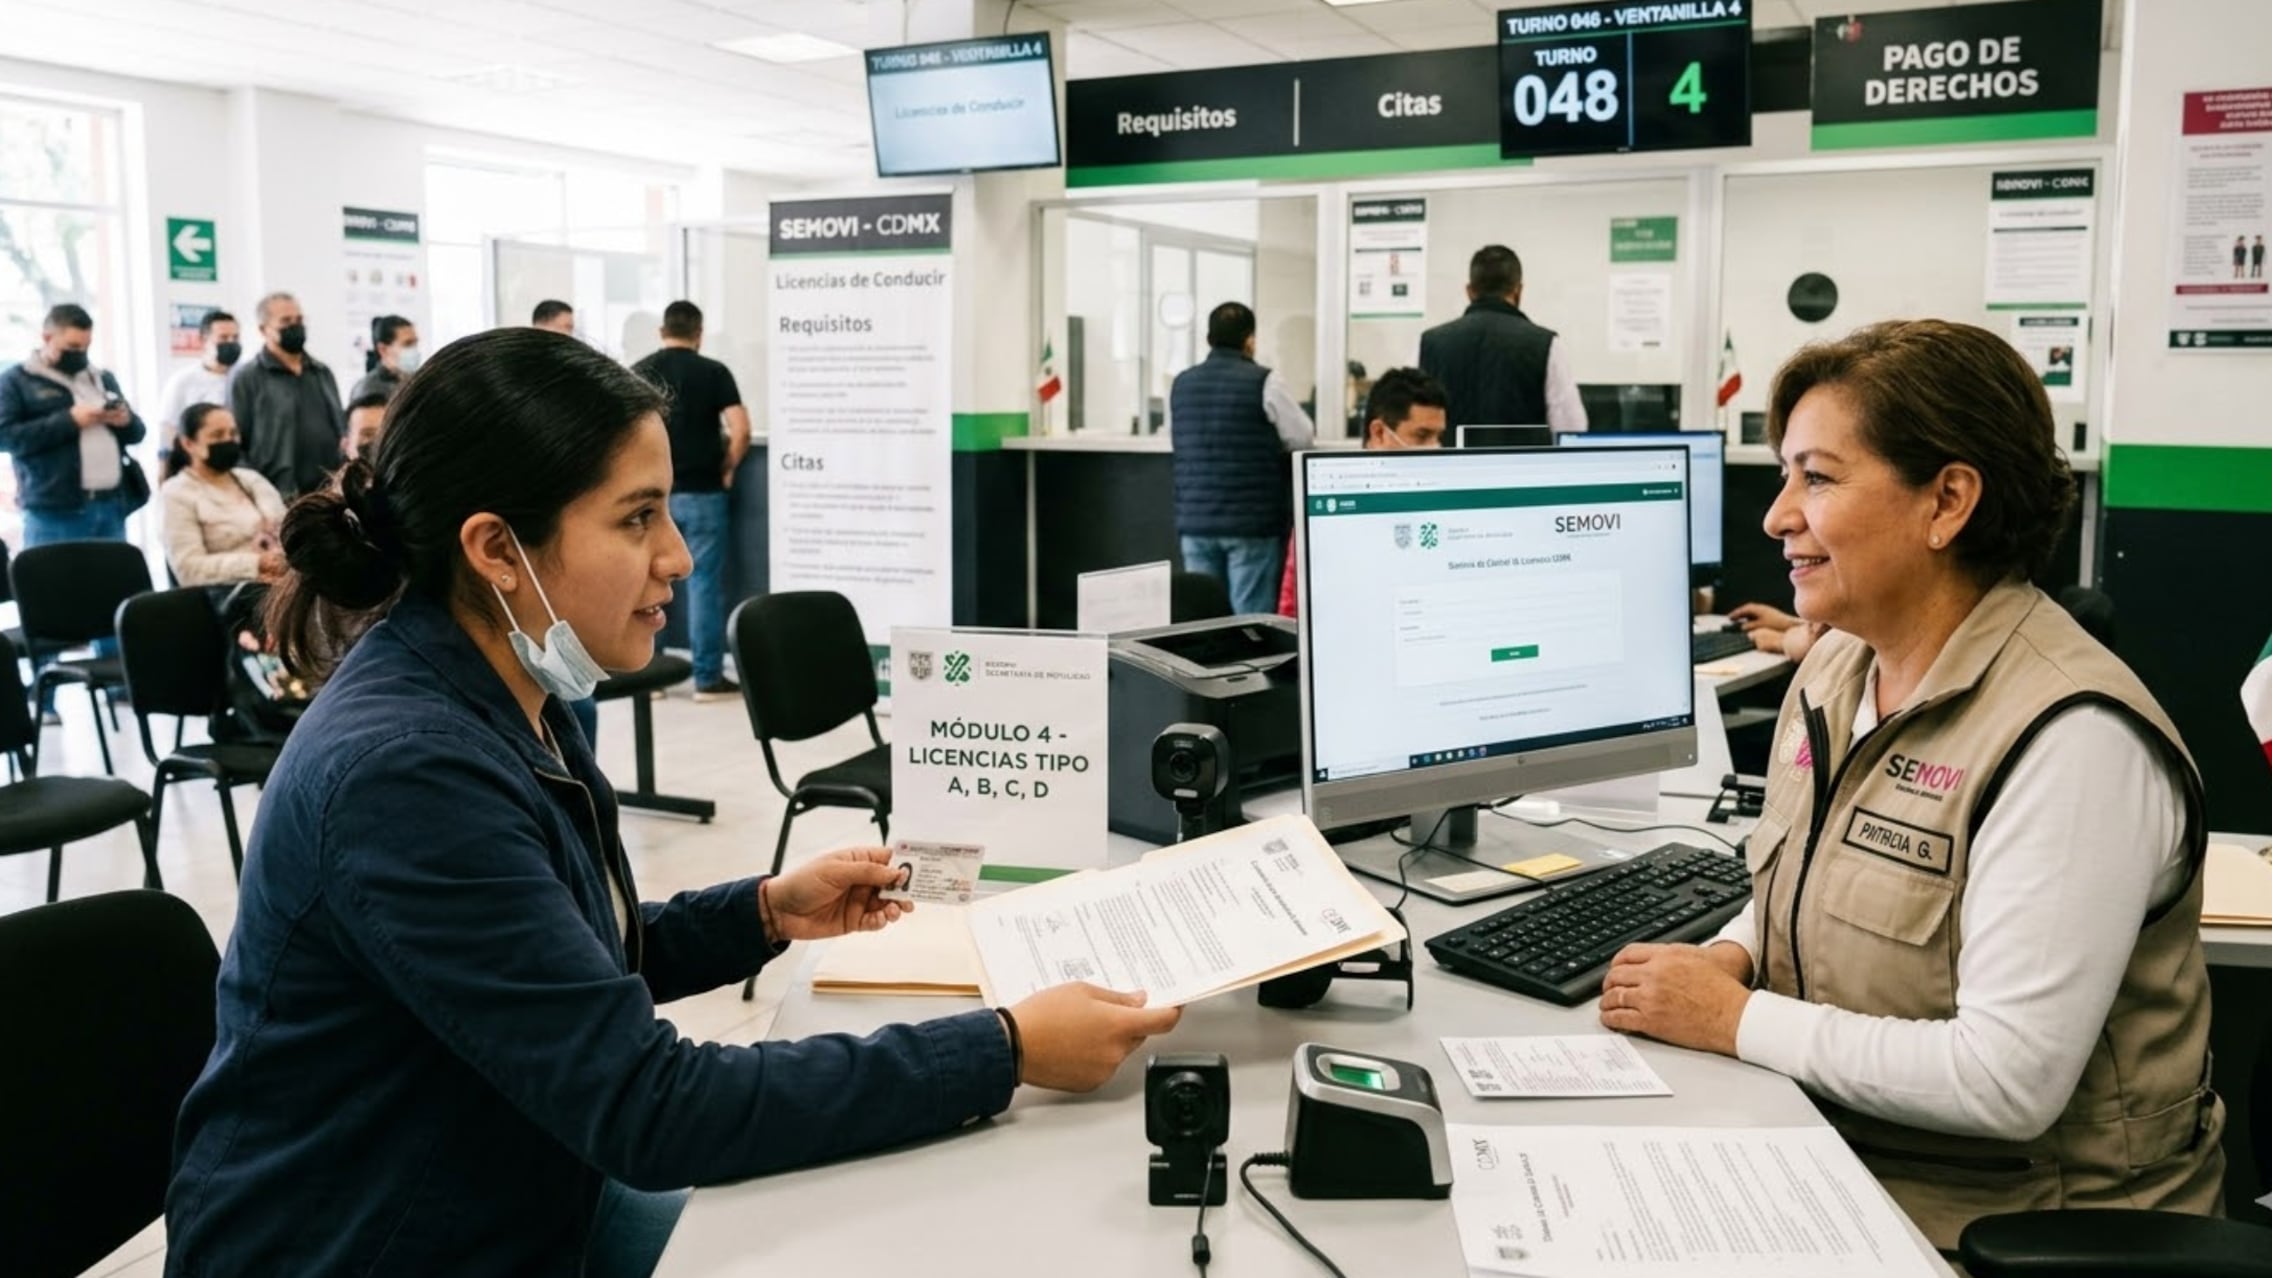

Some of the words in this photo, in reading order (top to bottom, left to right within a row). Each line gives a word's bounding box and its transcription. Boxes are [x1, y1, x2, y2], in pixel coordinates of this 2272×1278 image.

[1506, 13, 1569, 35] TURNO
[1613, 1, 1727, 26] VENTANILLA
[1728, 0, 1742, 16] 4
[1533, 45, 1598, 67] TURNO
[1883, 40, 1970, 72] PAGO
[1978, 36, 2021, 66] DE
[1513, 69, 1619, 126] 048
[1669, 61, 1707, 114] 4
[1864, 69, 2039, 106] DERECHOS
[1377, 91, 1442, 118] Citas
[1117, 105, 1237, 137] Requisitos
[779, 216, 859, 240] SEMOVI
[876, 212, 941, 236] CDMX
[775, 273, 847, 291] Licencias
[849, 272, 870, 288] de
[872, 268, 946, 288] Conducir
[779, 314, 873, 337] Requisitos
[780, 453, 825, 471] Citas
[1554, 513, 1621, 534] SEMOVI
[930, 716, 1031, 743] MÓDULO
[1037, 725, 1052, 744] 4
[909, 746, 1028, 770] LICENCIAS
[1034, 753, 1089, 773] TIPO
[947, 775, 970, 797] A,
[977, 777, 998, 799] B,
[1004, 779, 1026, 800] C,
[1033, 780, 1049, 799] D
